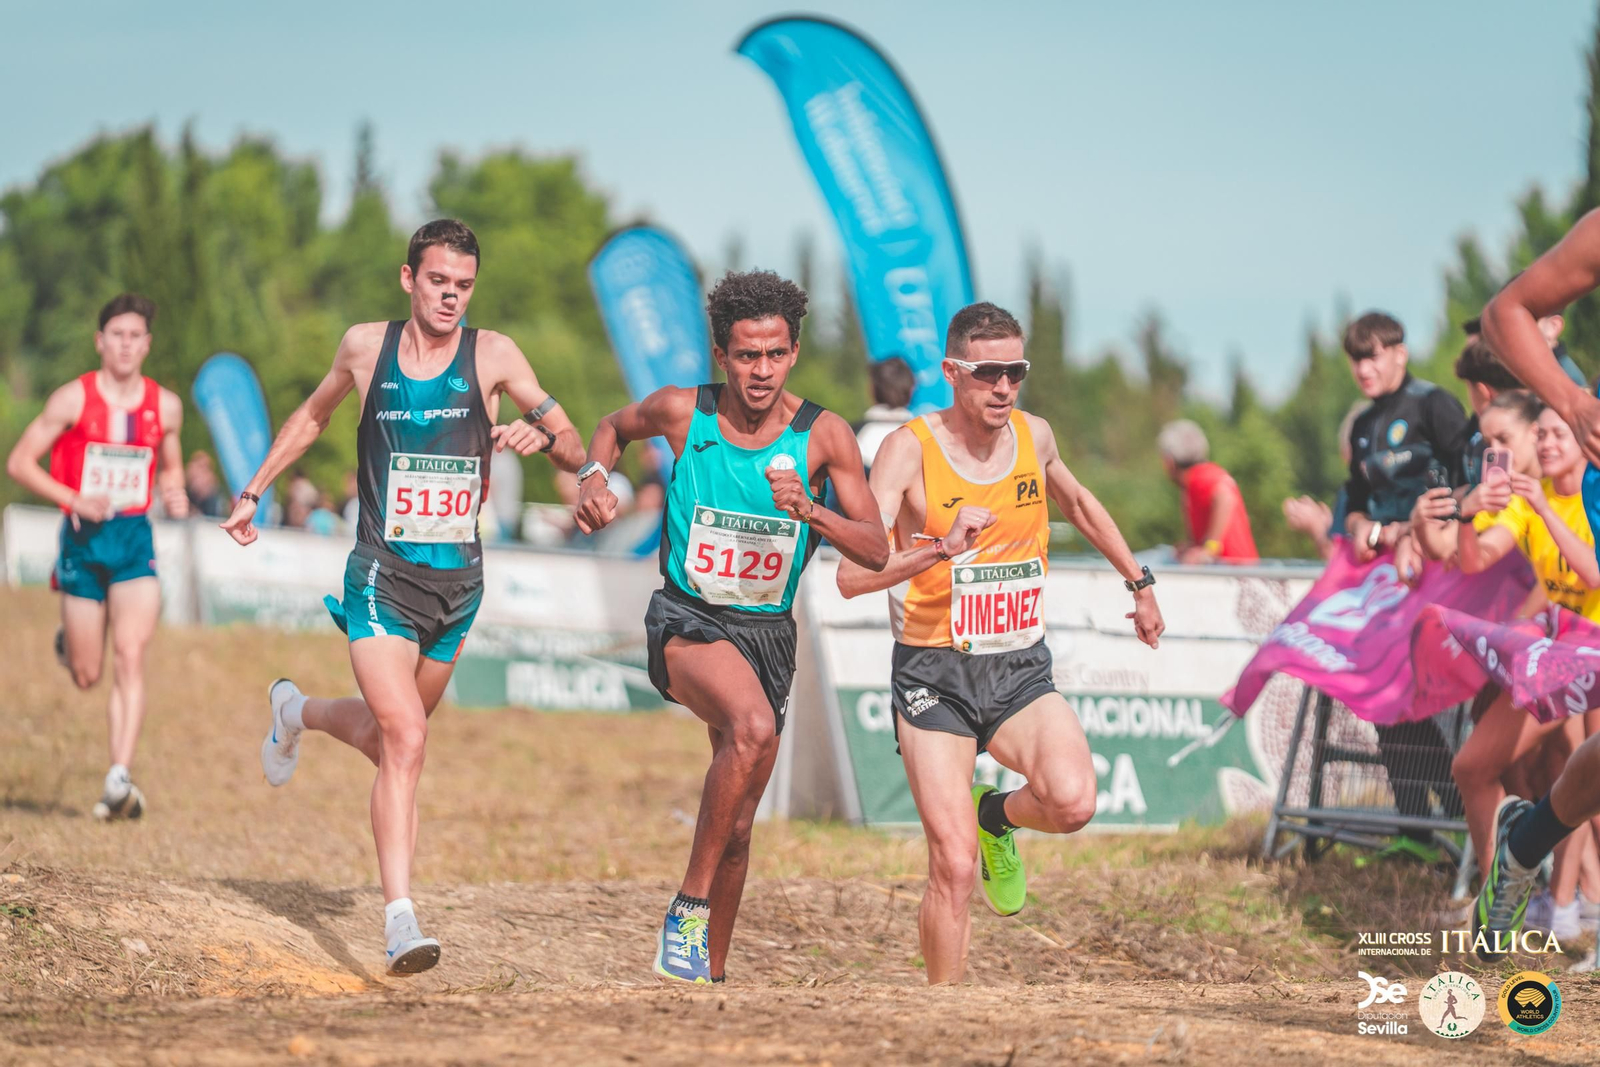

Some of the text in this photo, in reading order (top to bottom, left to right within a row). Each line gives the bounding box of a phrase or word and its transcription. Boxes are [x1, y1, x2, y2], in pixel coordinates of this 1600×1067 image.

[376, 408, 470, 420] META SPORT
[416, 458, 458, 471] ITÁLICA
[395, 487, 472, 517] 5130
[1017, 479, 1039, 502] PA
[721, 515, 770, 532] ITÁLICA
[694, 542, 783, 581] 5129
[980, 566, 1024, 580] ITÁLICA
[954, 582, 1041, 637] JIMÉNEZ
[1068, 695, 1213, 738] NACIONAL
